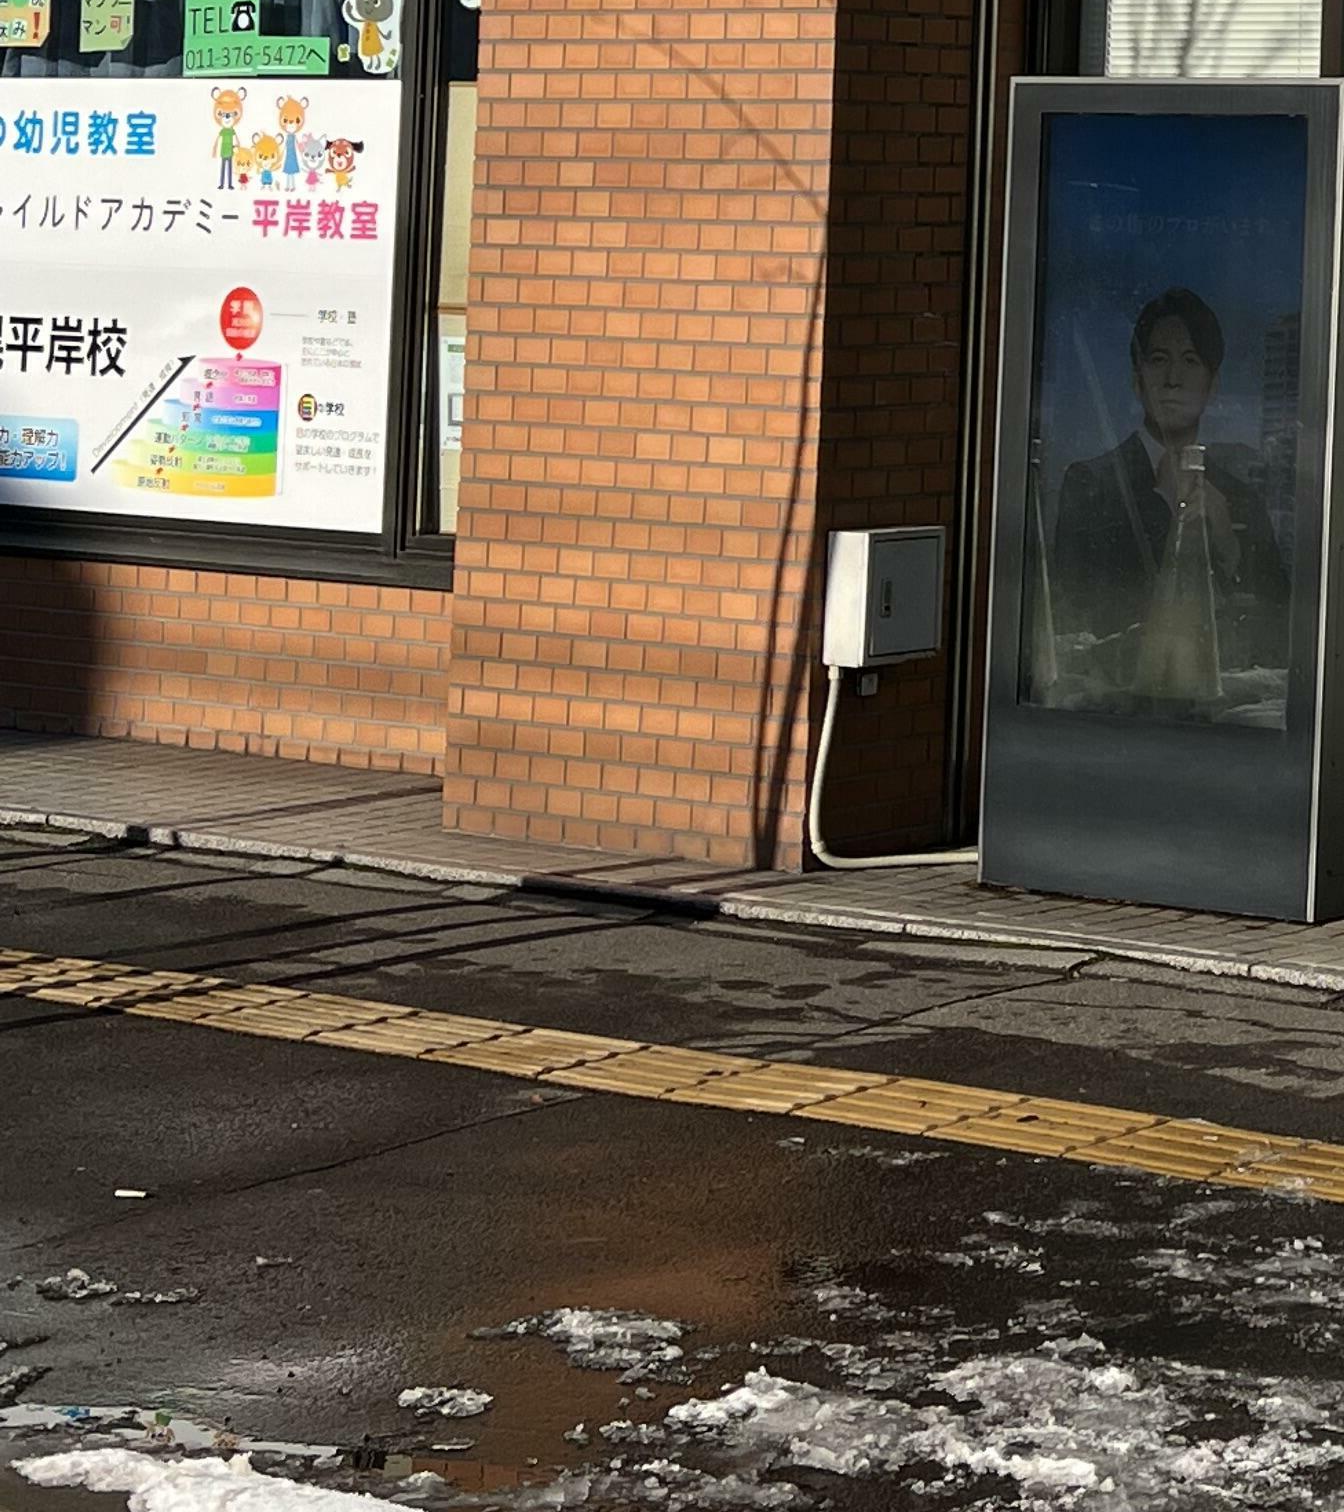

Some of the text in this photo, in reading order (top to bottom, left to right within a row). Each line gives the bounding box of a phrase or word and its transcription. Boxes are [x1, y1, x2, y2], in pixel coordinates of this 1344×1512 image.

[189, 5, 229, 36] TEL
[0, 109, 157, 156] 幼児教室
[0, 192, 380, 241] イルドアカデミー 平岸教室
[0, 315, 128, 377] 平岸校
